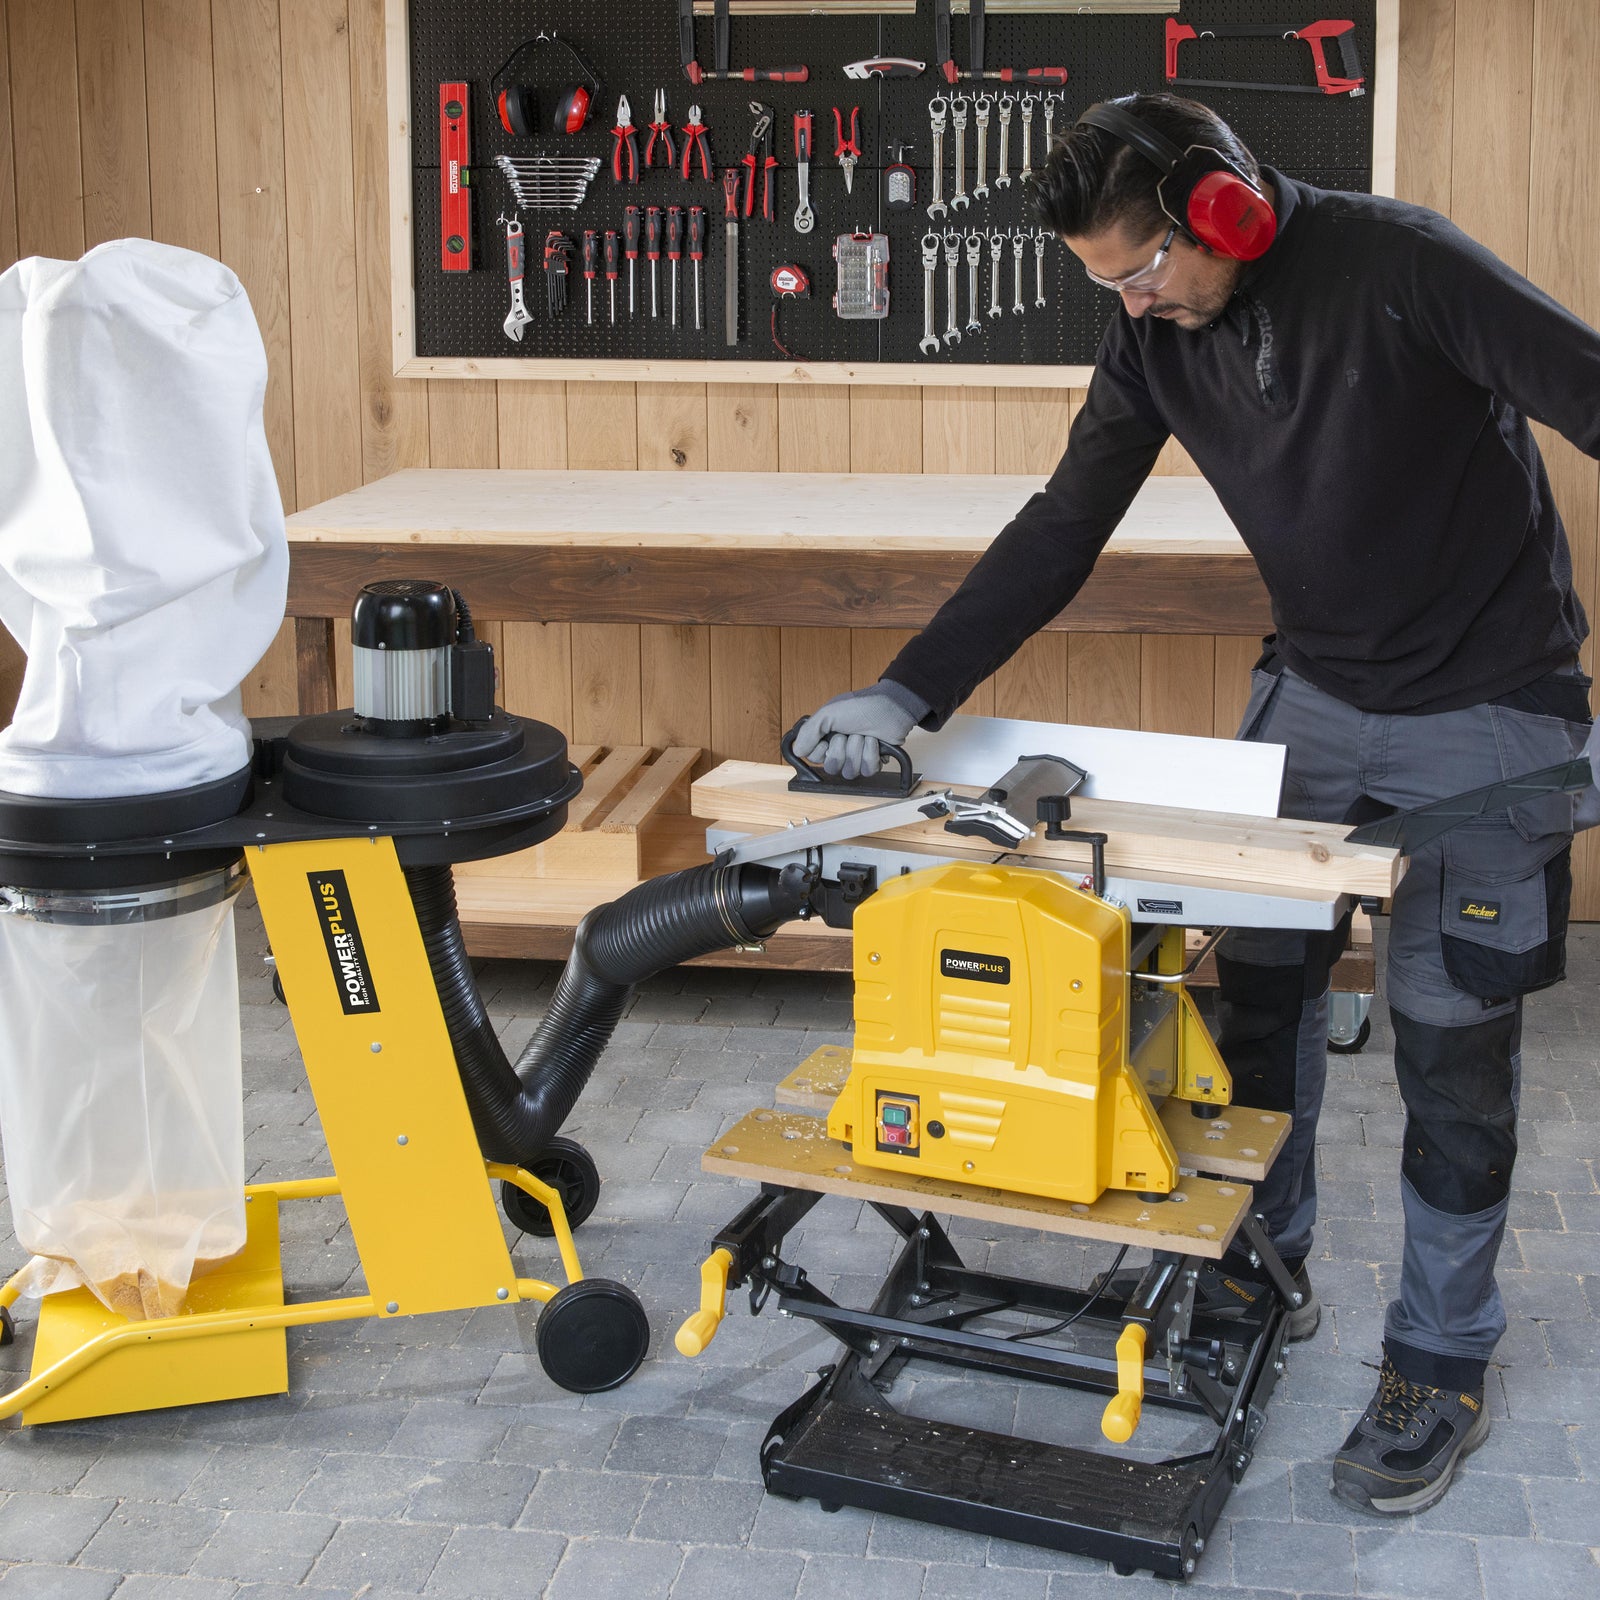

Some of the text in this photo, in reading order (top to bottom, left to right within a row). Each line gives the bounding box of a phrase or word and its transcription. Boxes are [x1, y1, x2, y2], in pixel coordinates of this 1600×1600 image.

[320, 882, 365, 1007] POWERPLUS
[347, 933, 370, 1005] HIGH QUALITY TOOLS
[945, 958, 1004, 973] POWERPLUS
